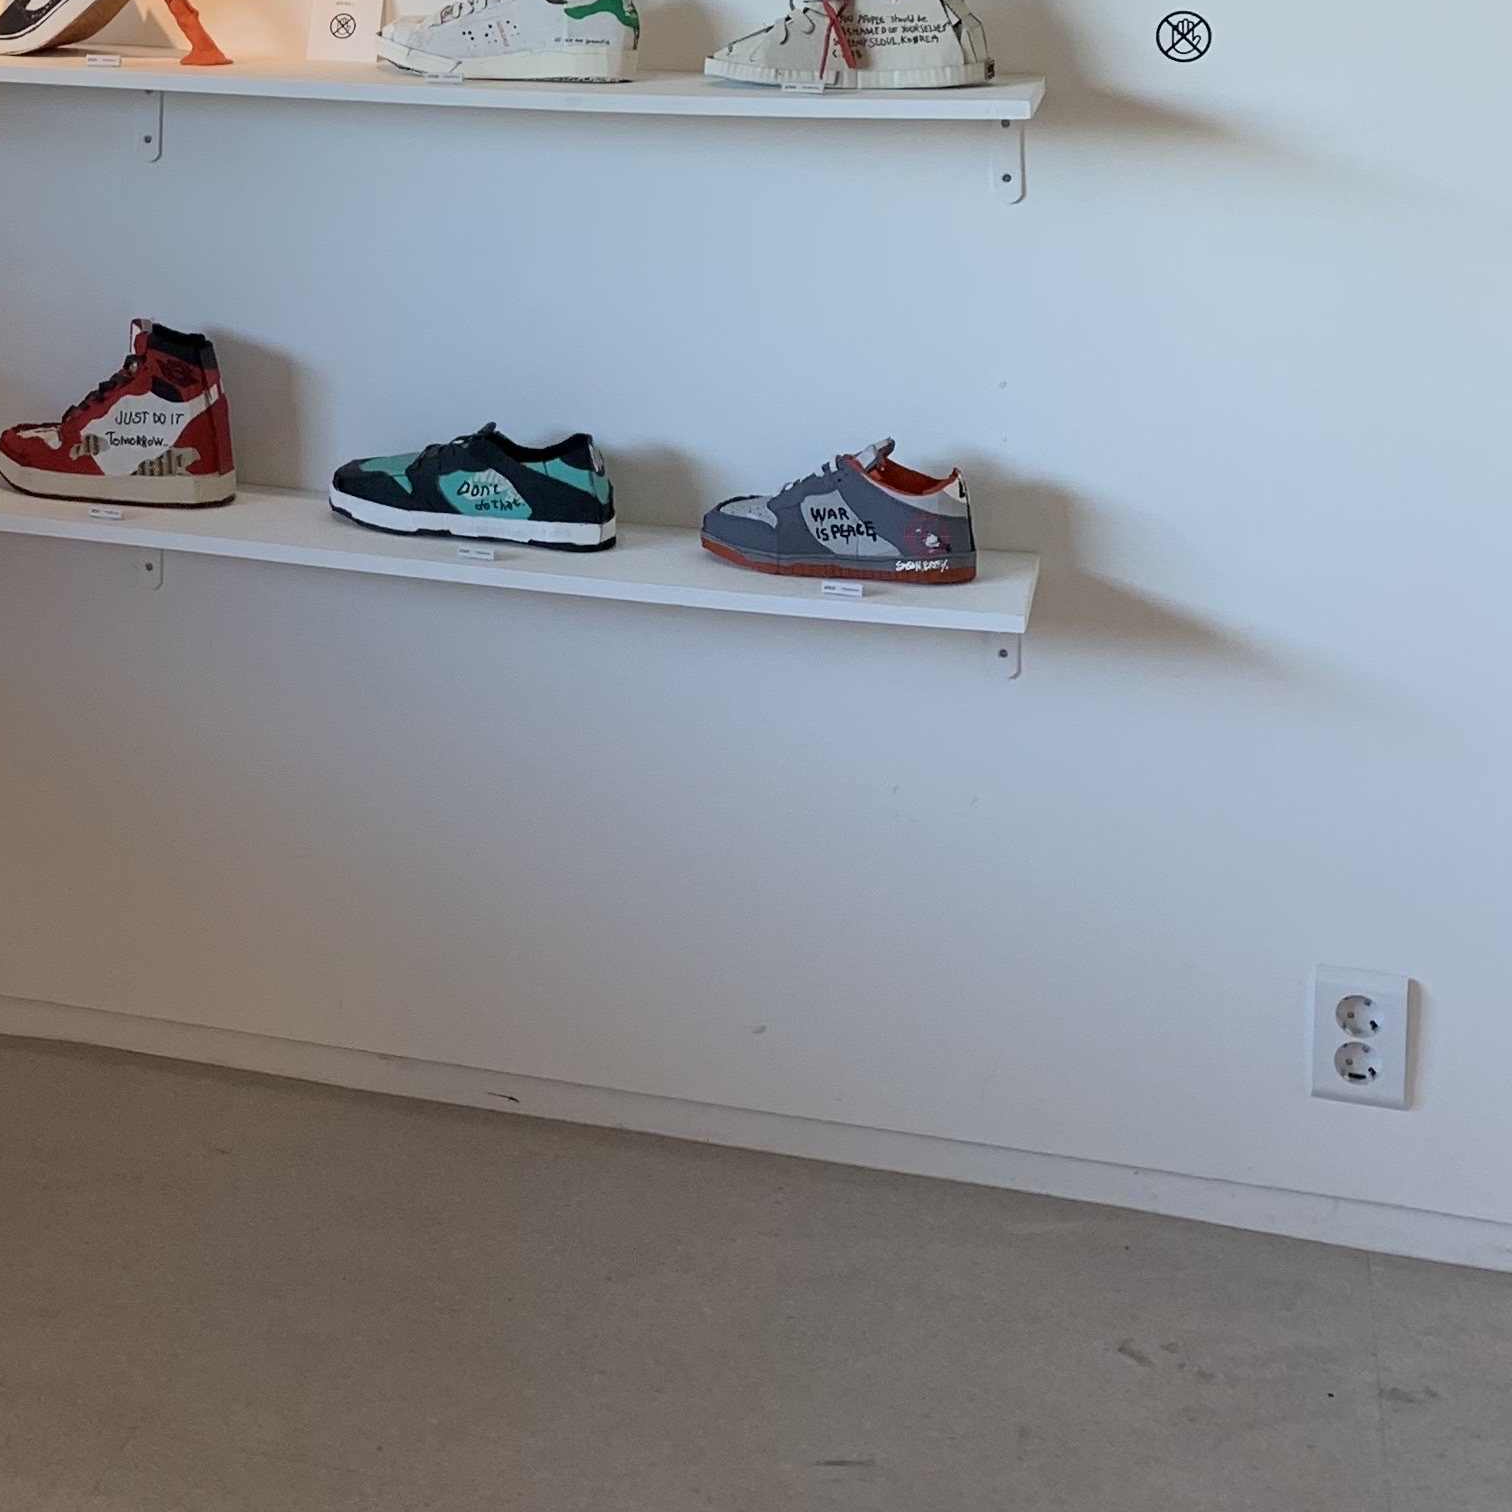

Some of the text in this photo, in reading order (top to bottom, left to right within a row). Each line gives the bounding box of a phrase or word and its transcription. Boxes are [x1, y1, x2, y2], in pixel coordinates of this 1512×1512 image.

[115, 410, 185, 425] JUST DO IT
[810, 507, 849, 522] WAR
[815, 527, 829, 541] IS
